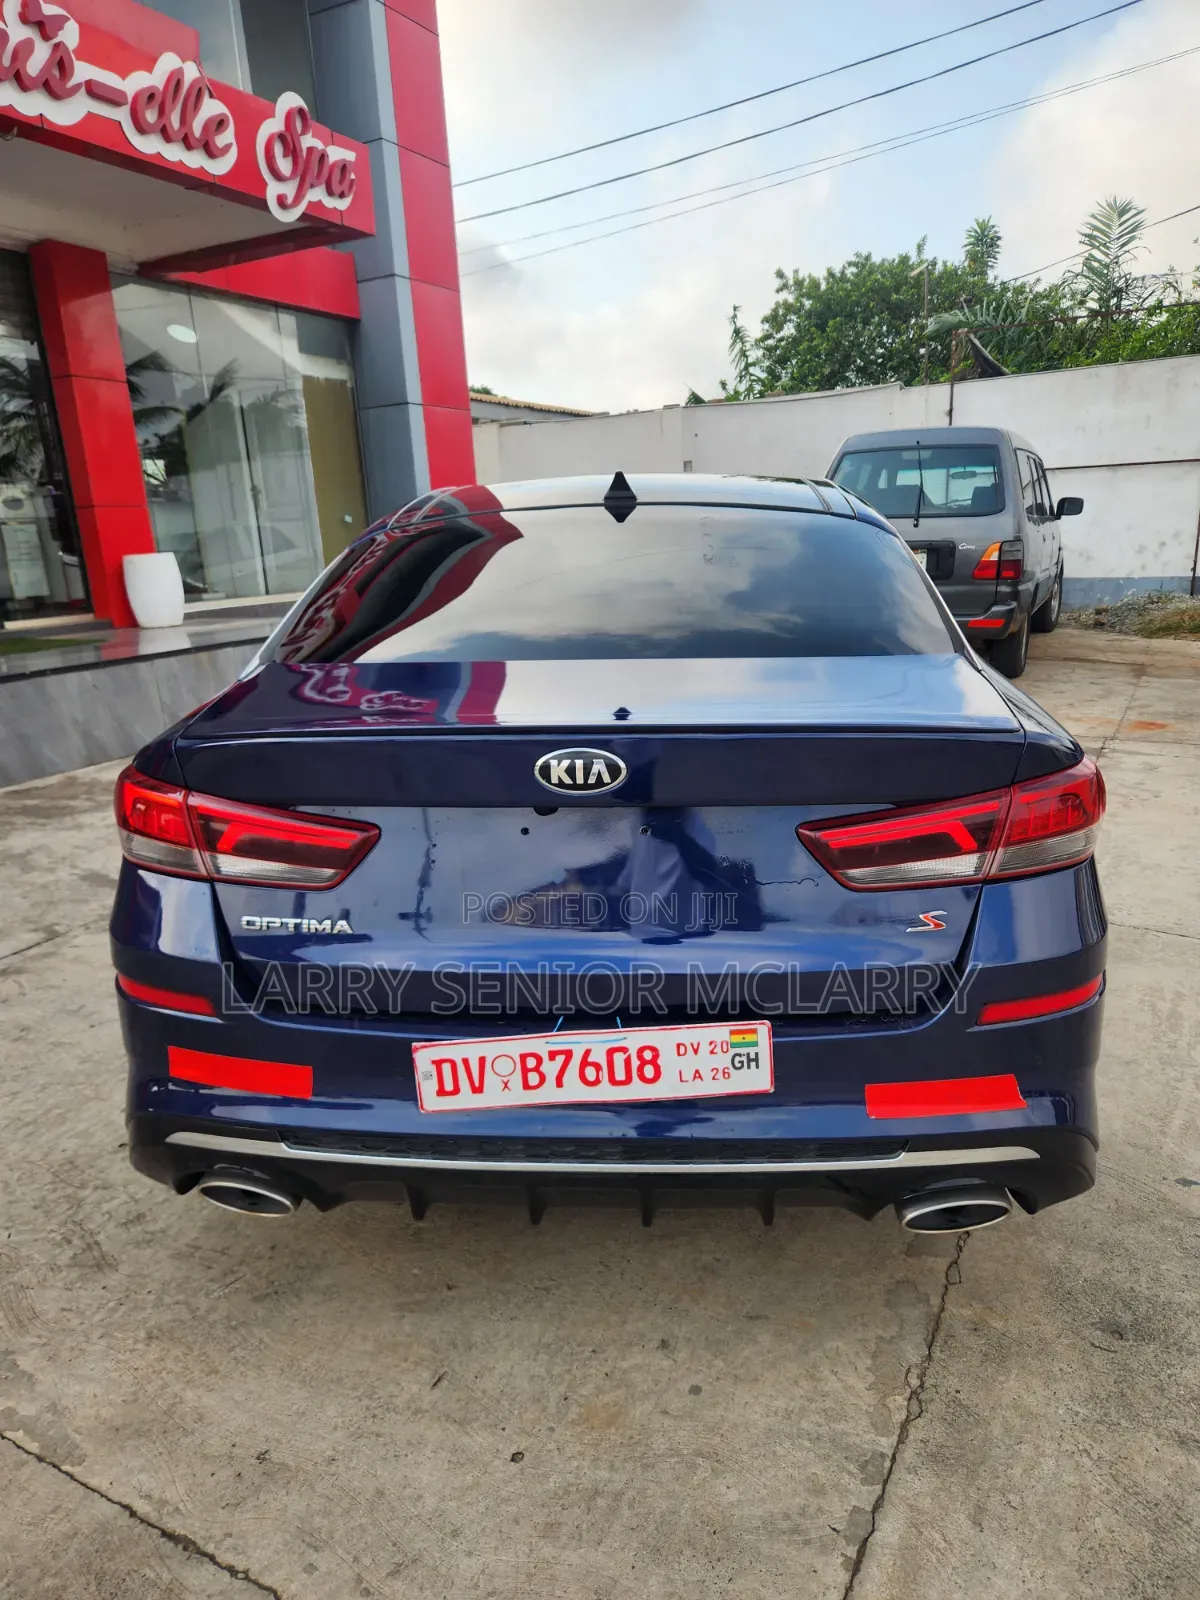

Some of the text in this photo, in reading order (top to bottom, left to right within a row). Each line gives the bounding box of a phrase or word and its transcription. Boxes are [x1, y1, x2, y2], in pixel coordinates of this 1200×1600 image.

[0, 26, 356, 210] is-elle Spa
[549, 758, 612, 785] KIA
[241, 916, 353, 934] OPTIMA
[905, 910, 947, 933] S
[676, 1040, 729, 1056] DV 20
[431, 1056, 486, 1096] DV
[519, 1045, 661, 1090] B7608
[731, 1052, 759, 1070] GH
[679, 1066, 731, 1082] LA 26
